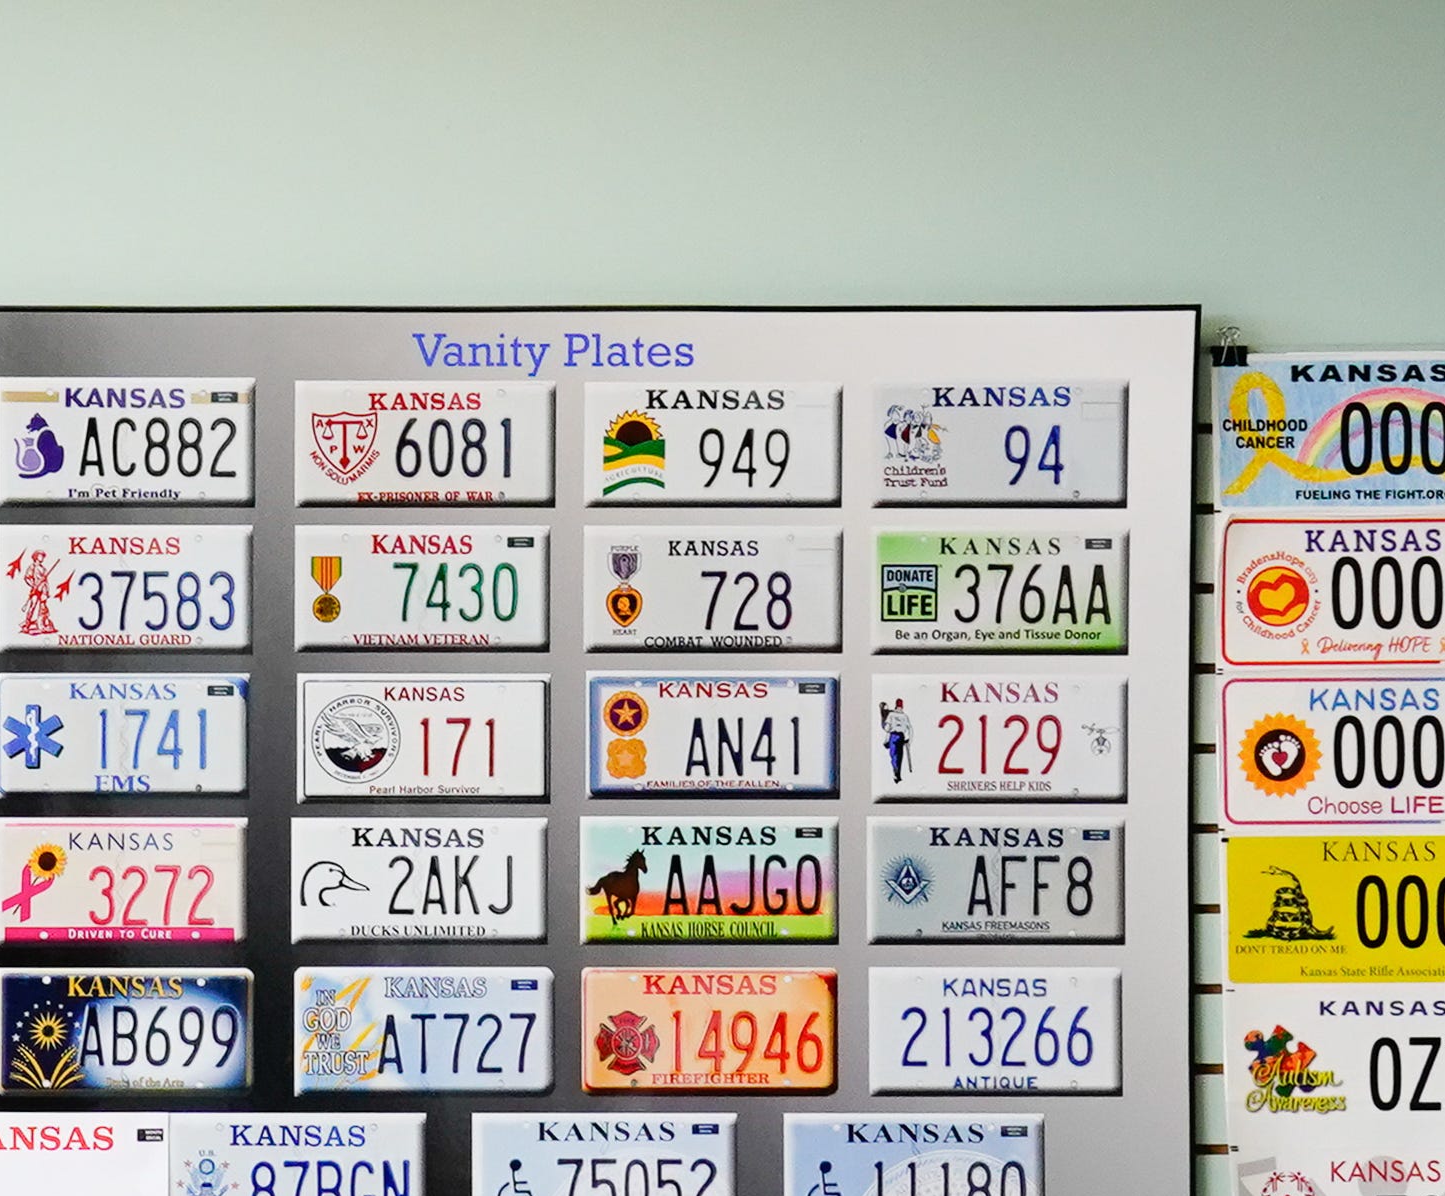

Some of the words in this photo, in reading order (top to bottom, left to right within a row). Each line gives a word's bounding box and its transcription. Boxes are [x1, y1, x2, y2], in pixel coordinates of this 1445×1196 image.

[413, 332, 550, 377] Vanity
[564, 333, 695, 368] Plates
[368, 392, 482, 411] KANSAS
[932, 387, 1071, 408] KANSAS
[1222, 419, 1308, 432] CHILDHOOD
[79, 416, 237, 478] AC882
[395, 417, 512, 478] 6081
[1235, 436, 1295, 449] CANCER
[699, 428, 790, 488] 949
[1004, 425, 1065, 486] 94
[1296, 489, 1352, 500] FUELING
[1355, 489, 1381, 500] THE
[371, 535, 473, 555] KANSAS
[667, 540, 759, 557] KANSAS
[886, 570, 933, 582] DONATE
[78, 571, 236, 631] 37583
[393, 562, 519, 622] 7430
[700, 571, 793, 632] 728
[955, 564, 1112, 625] 376AA
[886, 593, 933, 617] LIFE
[58, 634, 136, 646] NATIONAL
[139, 634, 192, 646] GUARD
[644, 636, 703, 648] COMBAT
[710, 636, 784, 648] WOUNDED
[895, 630, 910, 640] Be
[913, 632, 927, 640] an
[932, 630, 971, 643] Organ,
[975, 630, 996, 643] Eye
[1000, 630, 1020, 640] and
[1024, 630, 1060, 640] Tissue
[1065, 630, 1102, 640] Donor
[69, 682, 177, 701] KANSAS
[658, 682, 768, 699] KANSAS
[1309, 688, 1440, 711] KANSAS
[99, 708, 207, 771] 1741
[420, 717, 495, 777] 171
[686, 717, 800, 777] AN41
[938, 715, 1063, 776] 2129
[95, 775, 151, 793] EMS
[369, 785, 397, 795] Pearl
[400, 785, 434, 795] Harbor
[438, 785, 480, 795] Survivor
[1308, 796, 1383, 814] Choose
[1391, 796, 1445, 814] LIFE
[68, 832, 173, 851] KANSAS
[641, 826, 777, 846] KANSAS
[89, 865, 215, 927] 3272
[388, 855, 513, 916] 2AKJ
[967, 855, 1094, 917] AFF8
[351, 926, 401, 938] DUCKS
[404, 926, 486, 938] UNLIMITED
[67, 976, 184, 999] KANSAS
[384, 977, 487, 999] KANSAS
[942, 979, 1048, 998] KANSAS
[78, 1005, 239, 1068] AB699
[379, 1014, 537, 1075] AT727
[671, 1010, 824, 1074] 14946
[902, 1006, 1094, 1067] 213266
[651, 1072, 770, 1085] FIREFIGHTER
[952, 1076, 1038, 1090] ANTIQUE
[538, 1121, 676, 1142] KANSAS
